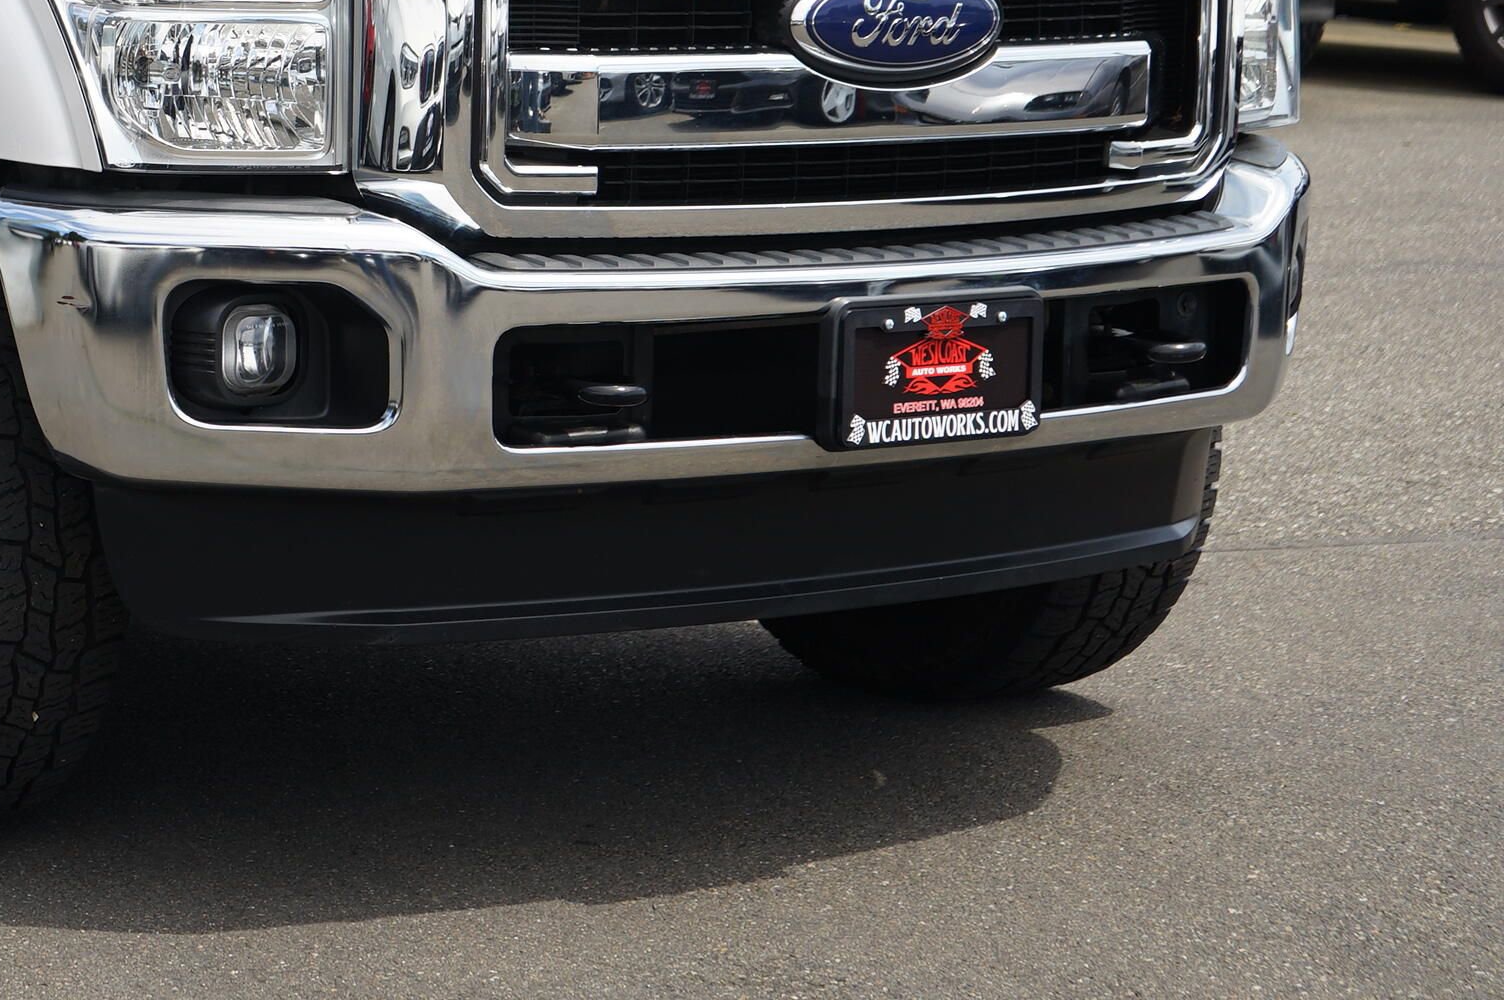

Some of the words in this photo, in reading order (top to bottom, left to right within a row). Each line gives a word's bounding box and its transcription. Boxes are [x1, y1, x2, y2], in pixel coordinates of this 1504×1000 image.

[911, 367, 935, 377] AUTO
[936, 365, 967, 375] WORKS
[893, 399, 939, 414] EVERETT,
[940, 398, 957, 411] WA
[867, 409, 1020, 444] WCAUTOWORKS.COM
